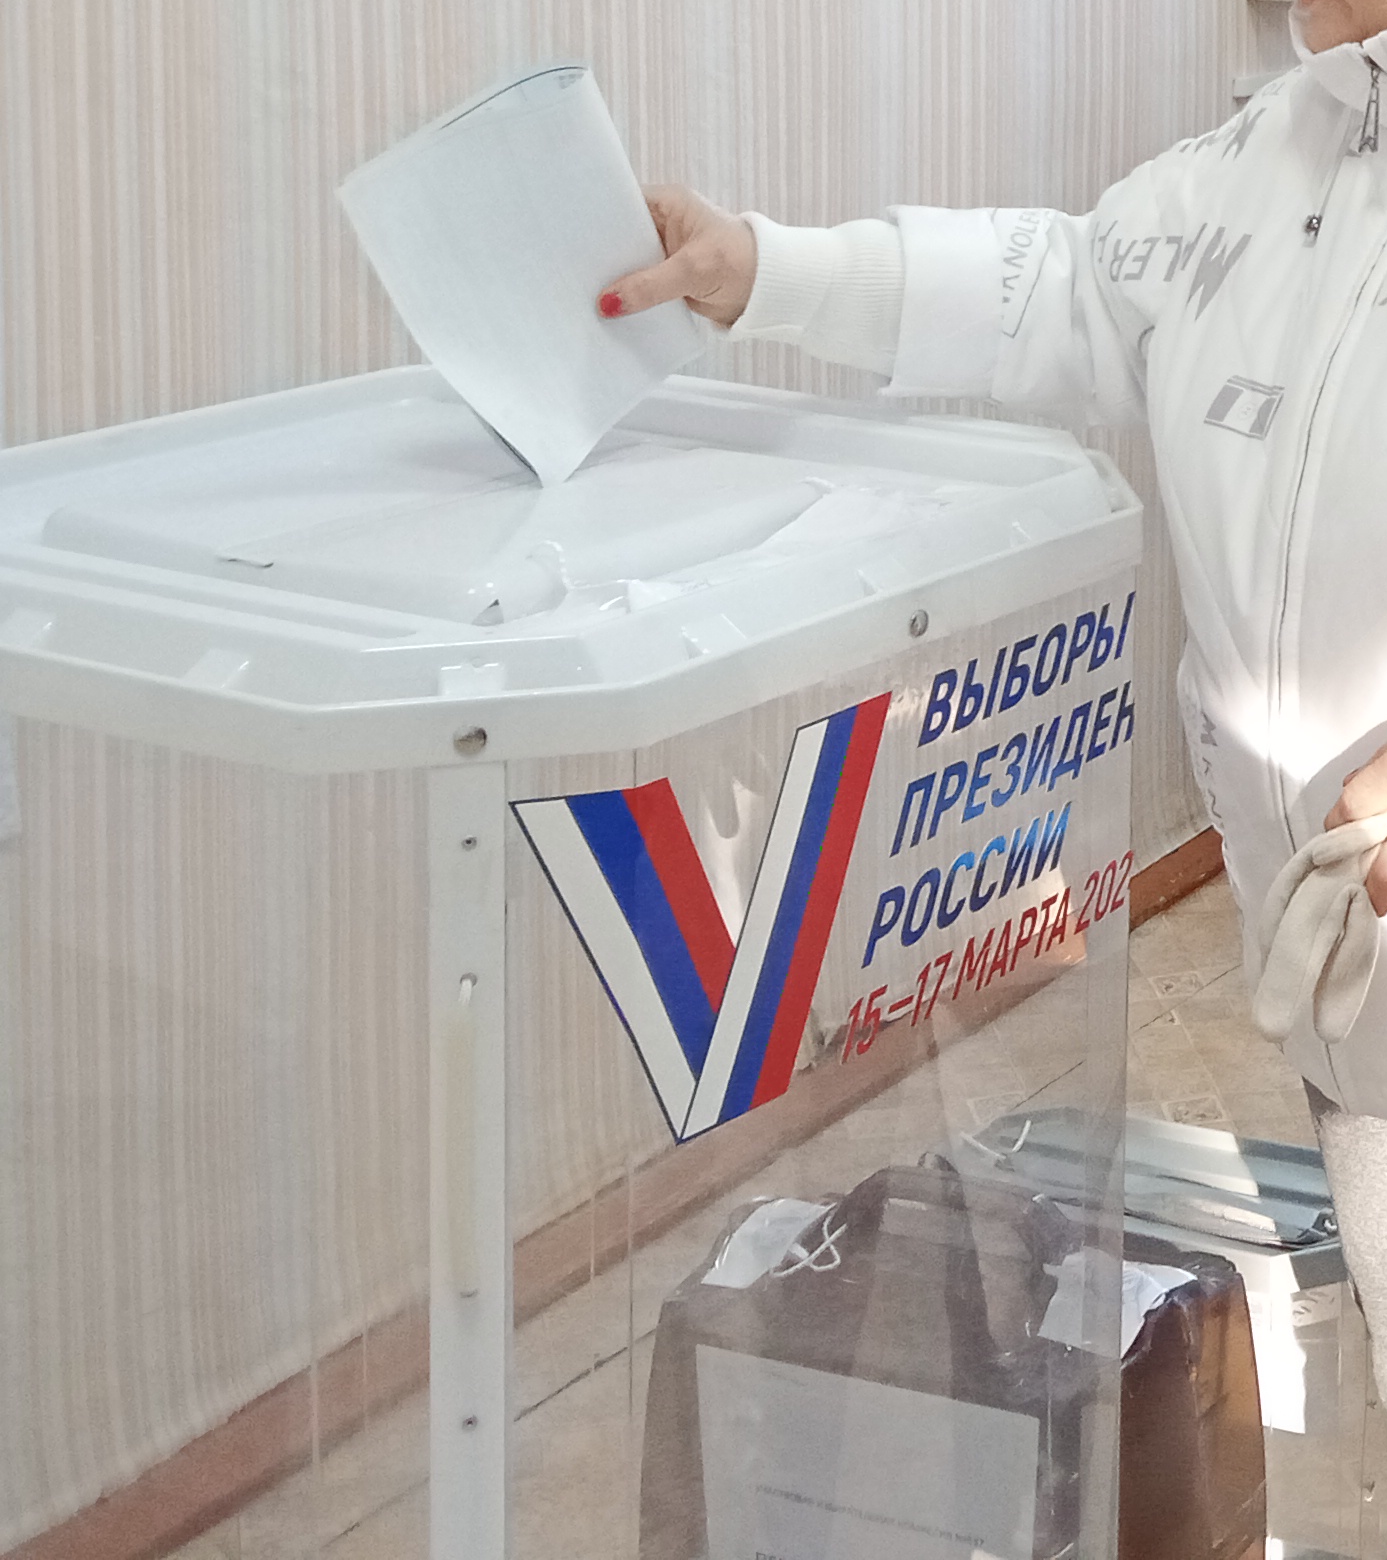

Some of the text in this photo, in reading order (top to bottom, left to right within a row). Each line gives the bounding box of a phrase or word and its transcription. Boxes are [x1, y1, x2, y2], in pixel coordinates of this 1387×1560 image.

[917, 591, 1136, 747] ВЫБОРЫ
[861, 801, 1072, 969] РОССИИ
[952, 886, 1071, 1000] МАРТА
